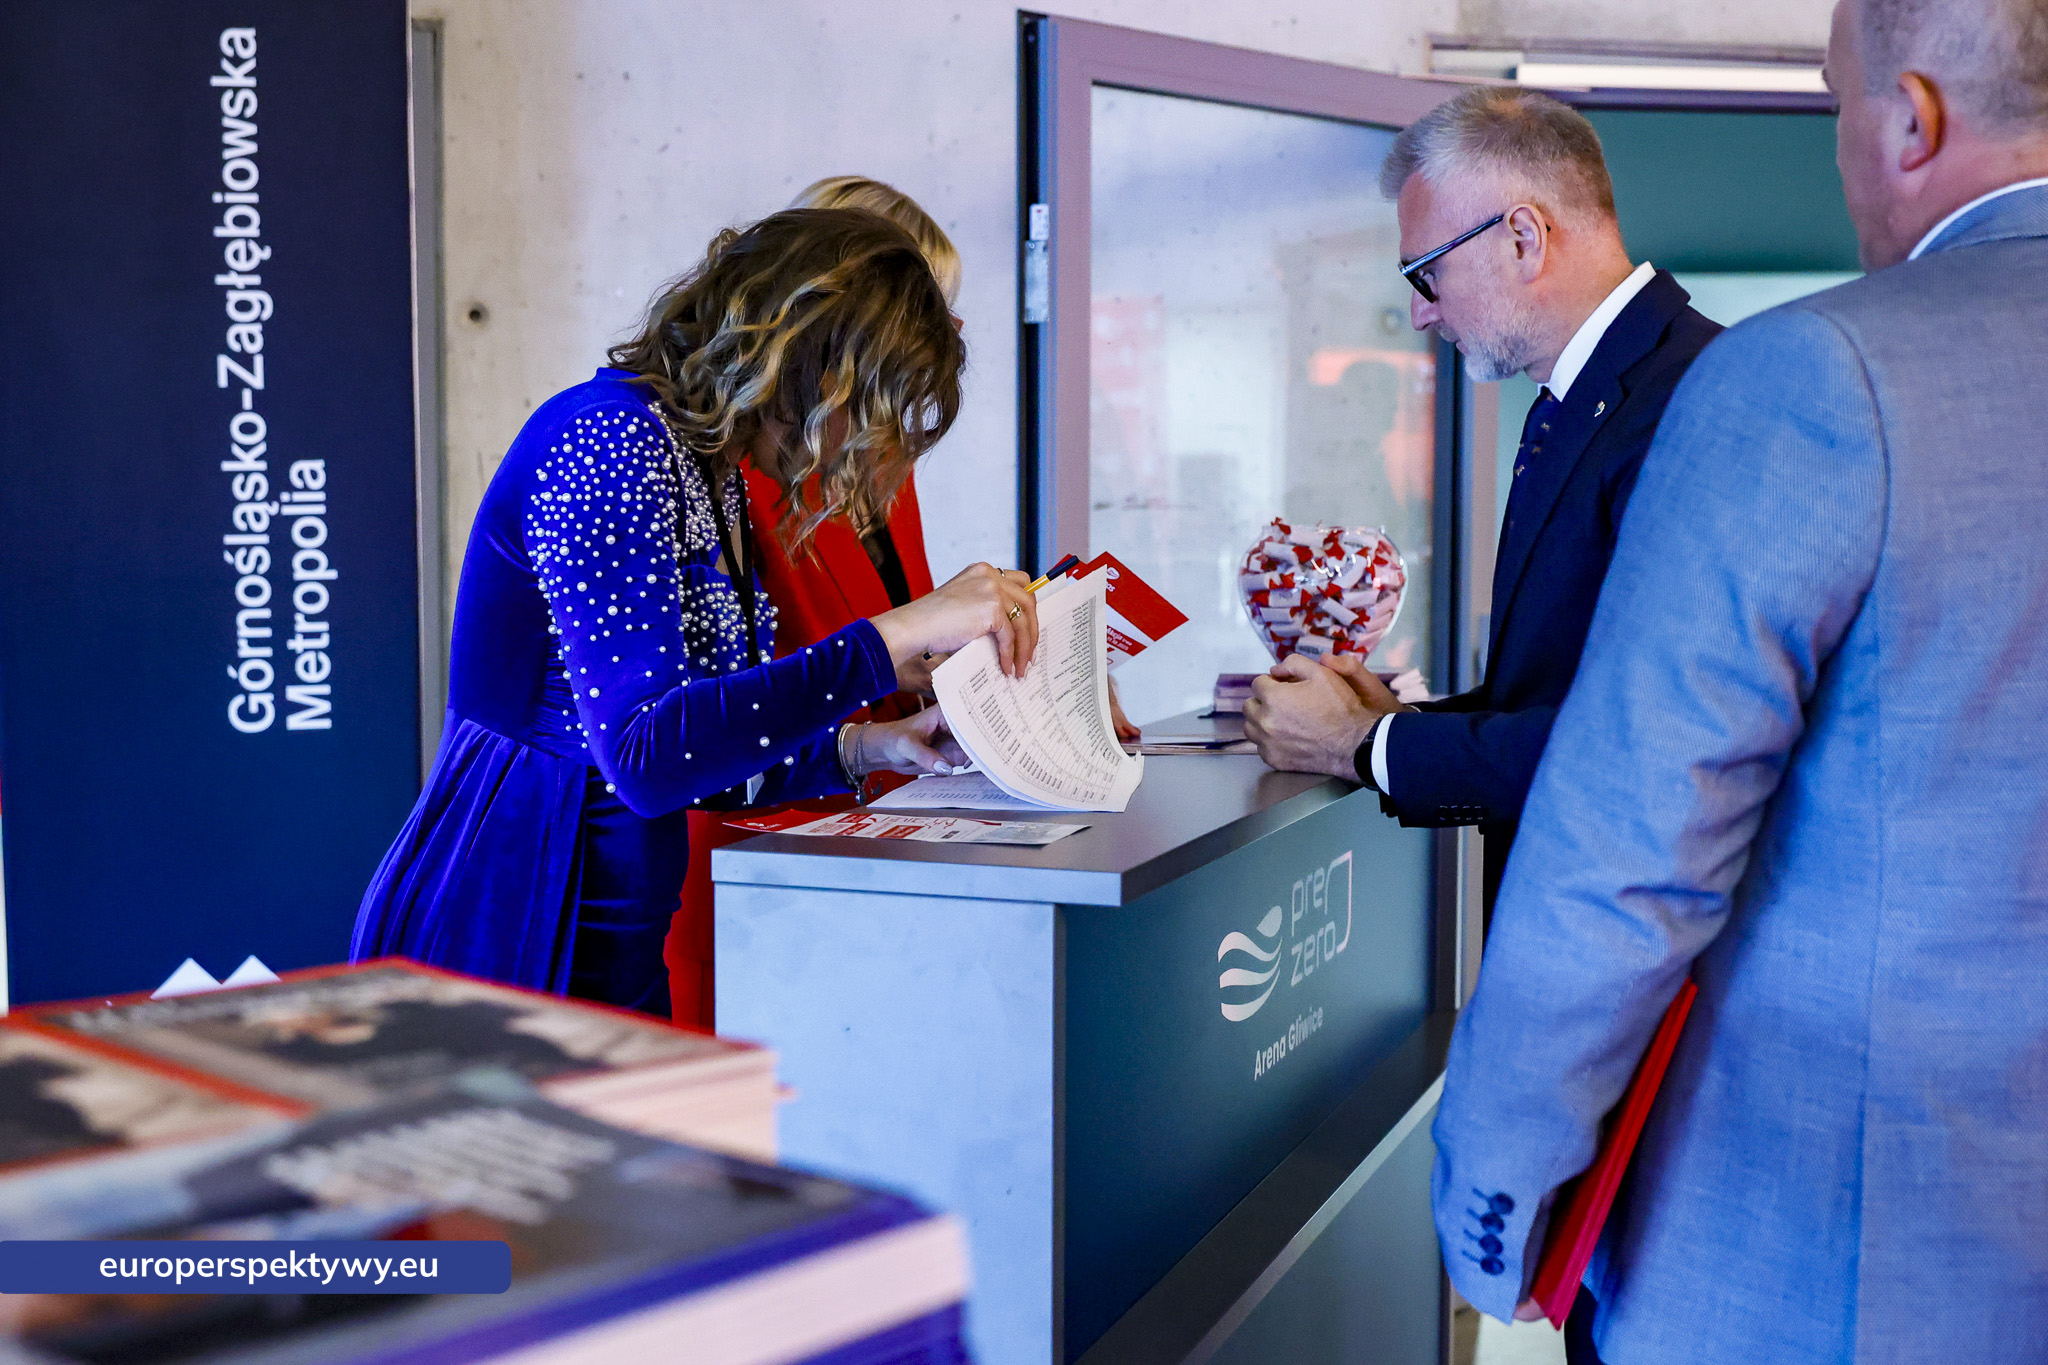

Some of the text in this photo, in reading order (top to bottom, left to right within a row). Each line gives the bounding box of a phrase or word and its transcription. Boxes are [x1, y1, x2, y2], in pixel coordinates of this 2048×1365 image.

[209, 27, 279, 734] Górnośląsko-Zagłębiowska
[280, 459, 339, 730] Metropolia
[1290, 919, 1336, 988] zero
[1254, 1006, 1324, 1081] Arena Gliwice
